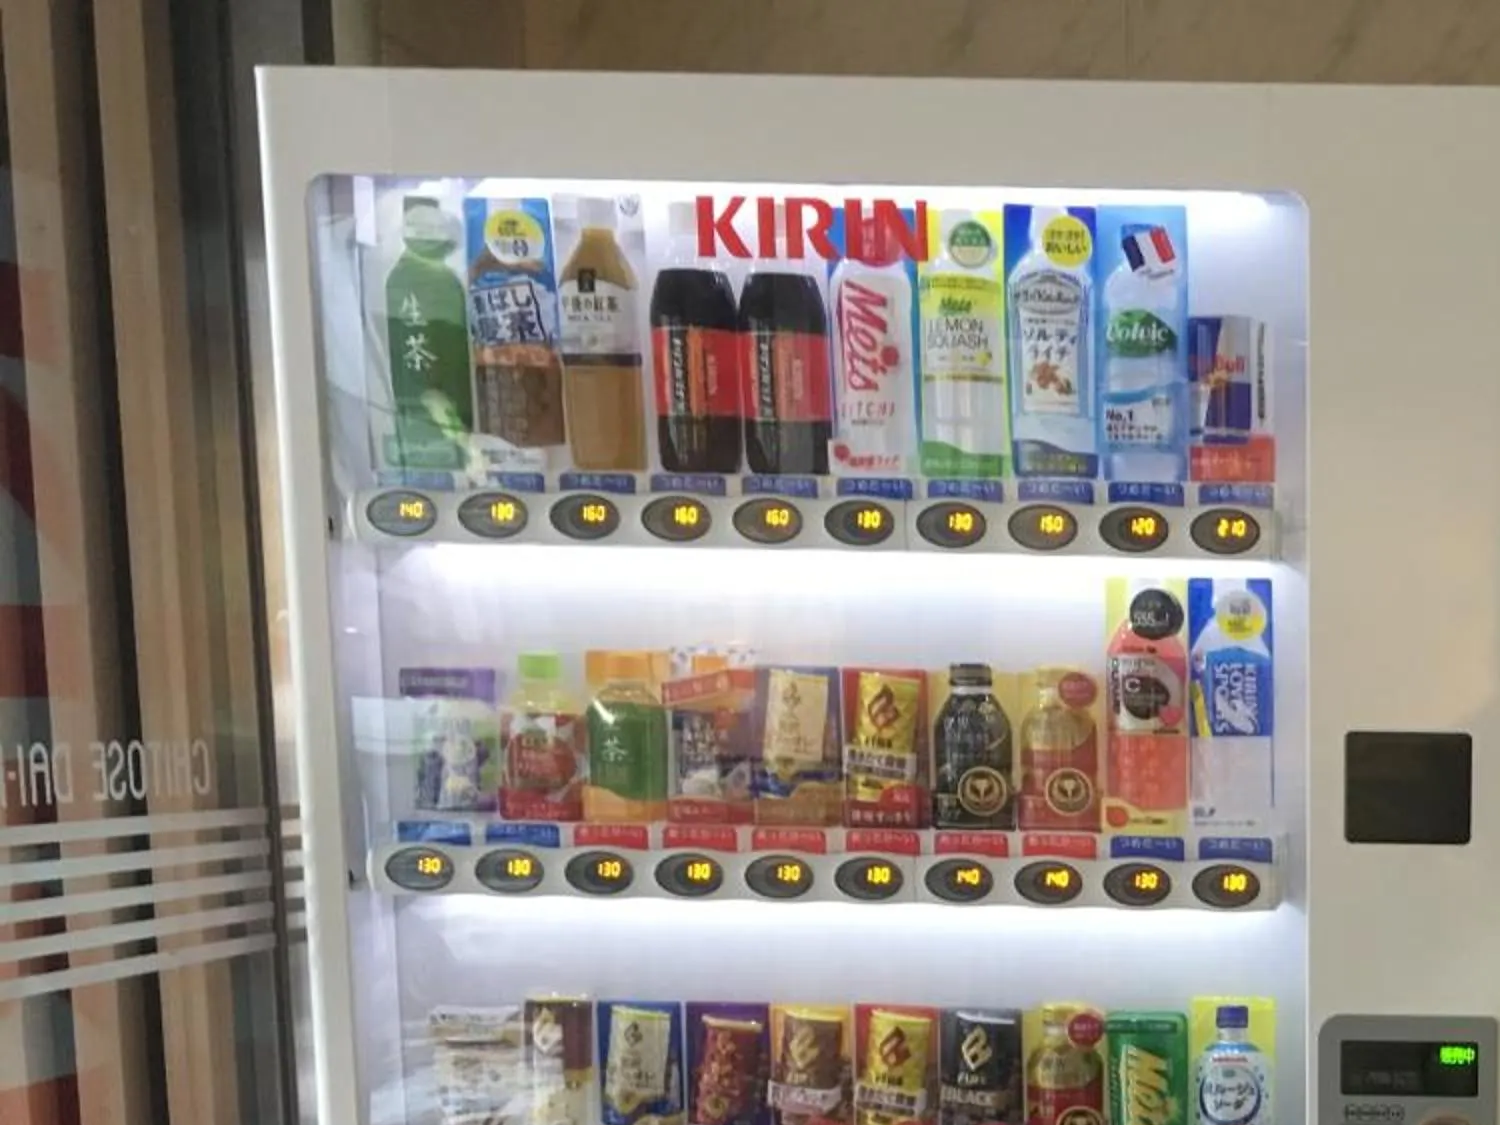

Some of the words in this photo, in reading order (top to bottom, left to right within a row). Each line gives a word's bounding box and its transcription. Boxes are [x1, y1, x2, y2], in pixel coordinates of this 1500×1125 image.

[696, 196, 928, 261] KIRIN
[402, 293, 437, 371] 生茶
[928, 317, 985, 333] LEMON
[1106, 322, 1170, 343] Volvic
[841, 280, 890, 391] Mets
[926, 332, 990, 350] SQUASH
[1106, 409, 1134, 421] No.1
[400, 502, 423, 517] 140
[584, 506, 605, 521] 160
[766, 509, 788, 525] 160
[1218, 520, 1245, 536] 210
[419, 858, 440, 873] 130
[599, 862, 620, 876] 130
[779, 866, 800, 880] 130
